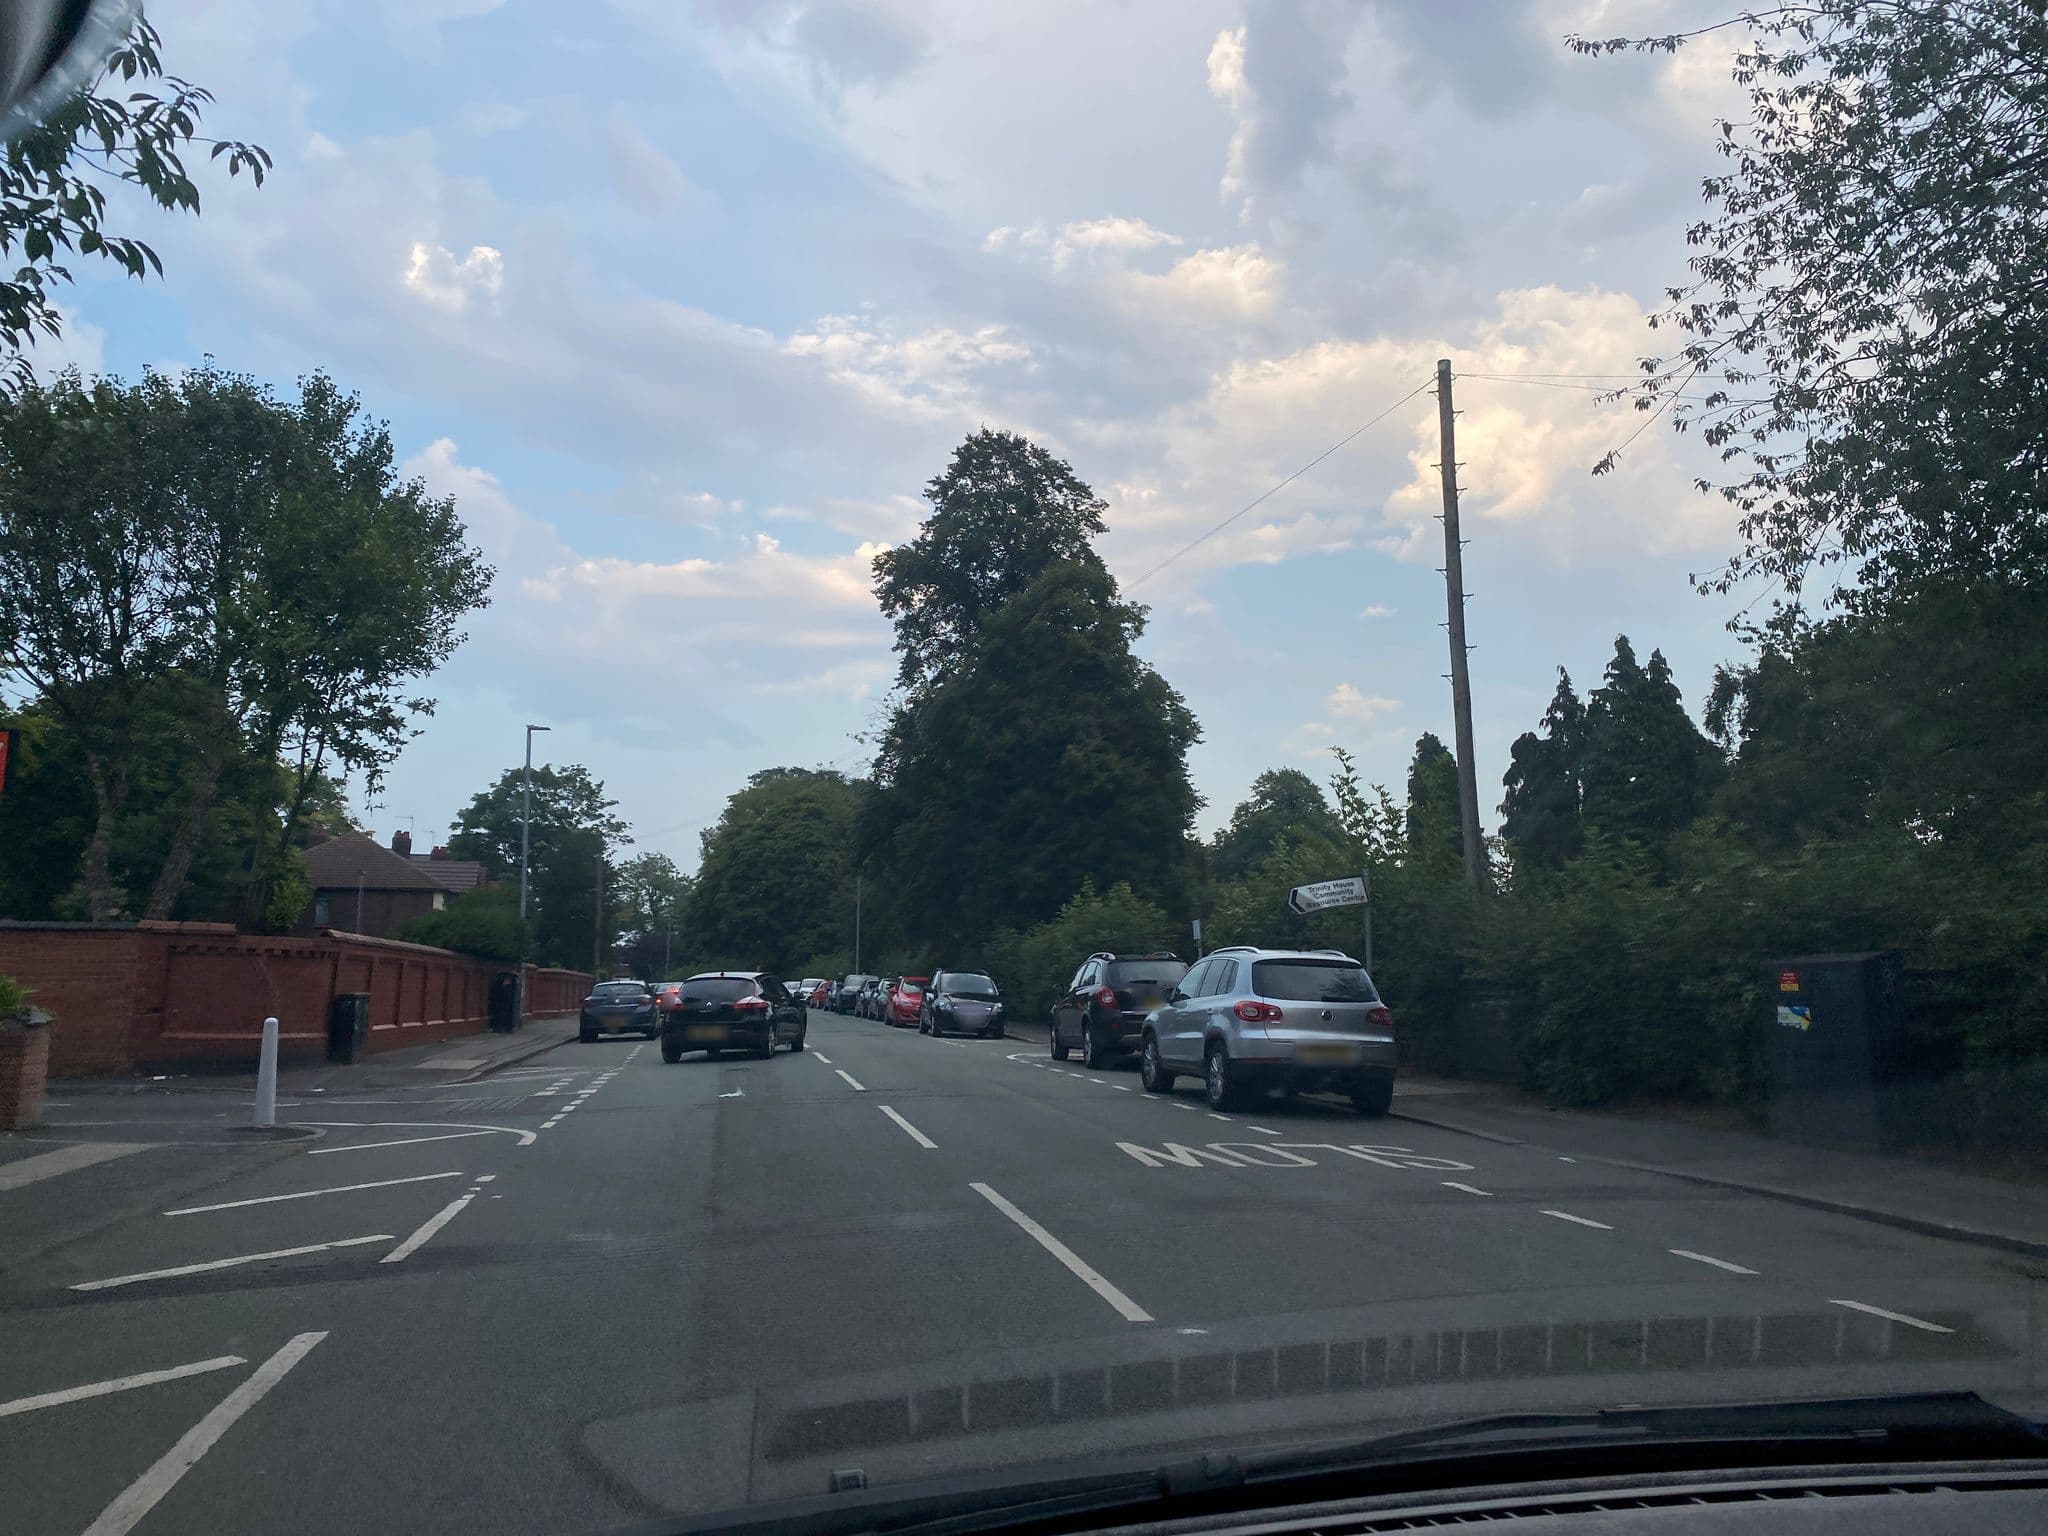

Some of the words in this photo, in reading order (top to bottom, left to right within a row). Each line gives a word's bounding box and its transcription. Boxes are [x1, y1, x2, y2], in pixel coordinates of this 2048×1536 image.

[1307, 884, 1331, 893] Trinity
[1333, 881, 1355, 889] House
[1314, 888, 1354, 899] Community
[1306, 899, 1340, 908] Resource
[1115, 1142, 1475, 1171] SLOW
